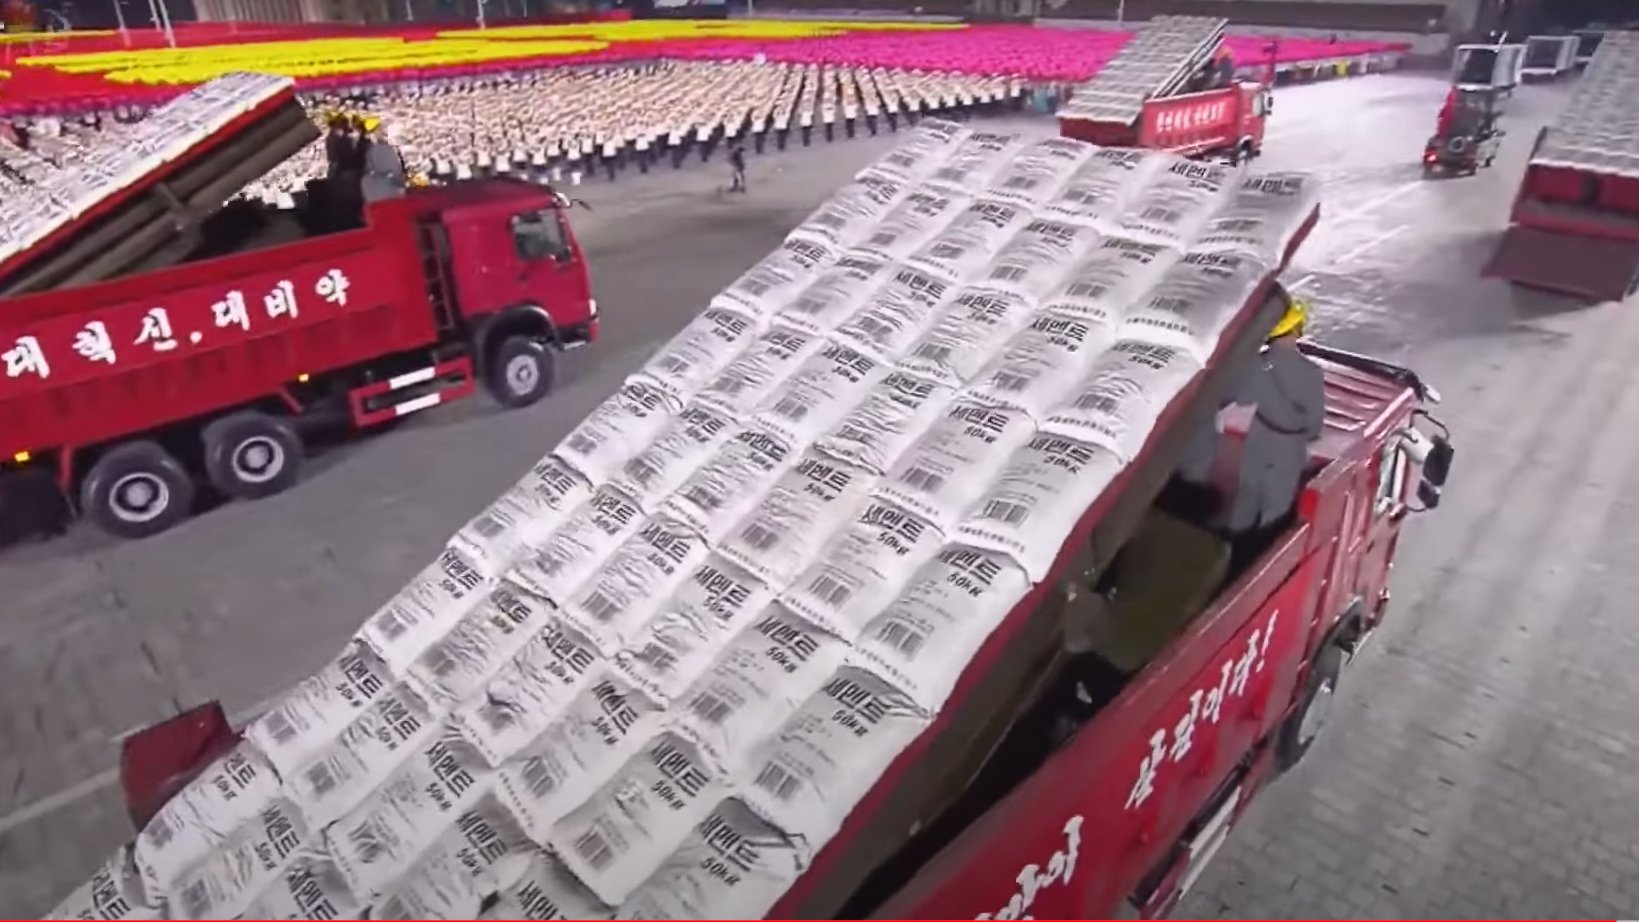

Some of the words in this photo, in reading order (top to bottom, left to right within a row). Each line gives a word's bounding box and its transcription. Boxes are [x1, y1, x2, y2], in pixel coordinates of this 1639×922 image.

[949, 405, 1009, 433] 세멘트
[861, 504, 925, 544] 세멘트
[936, 550, 1001, 585] 세멘트
[752, 616, 819, 662] 세멘트
[650, 741, 710, 797] 세멘트
